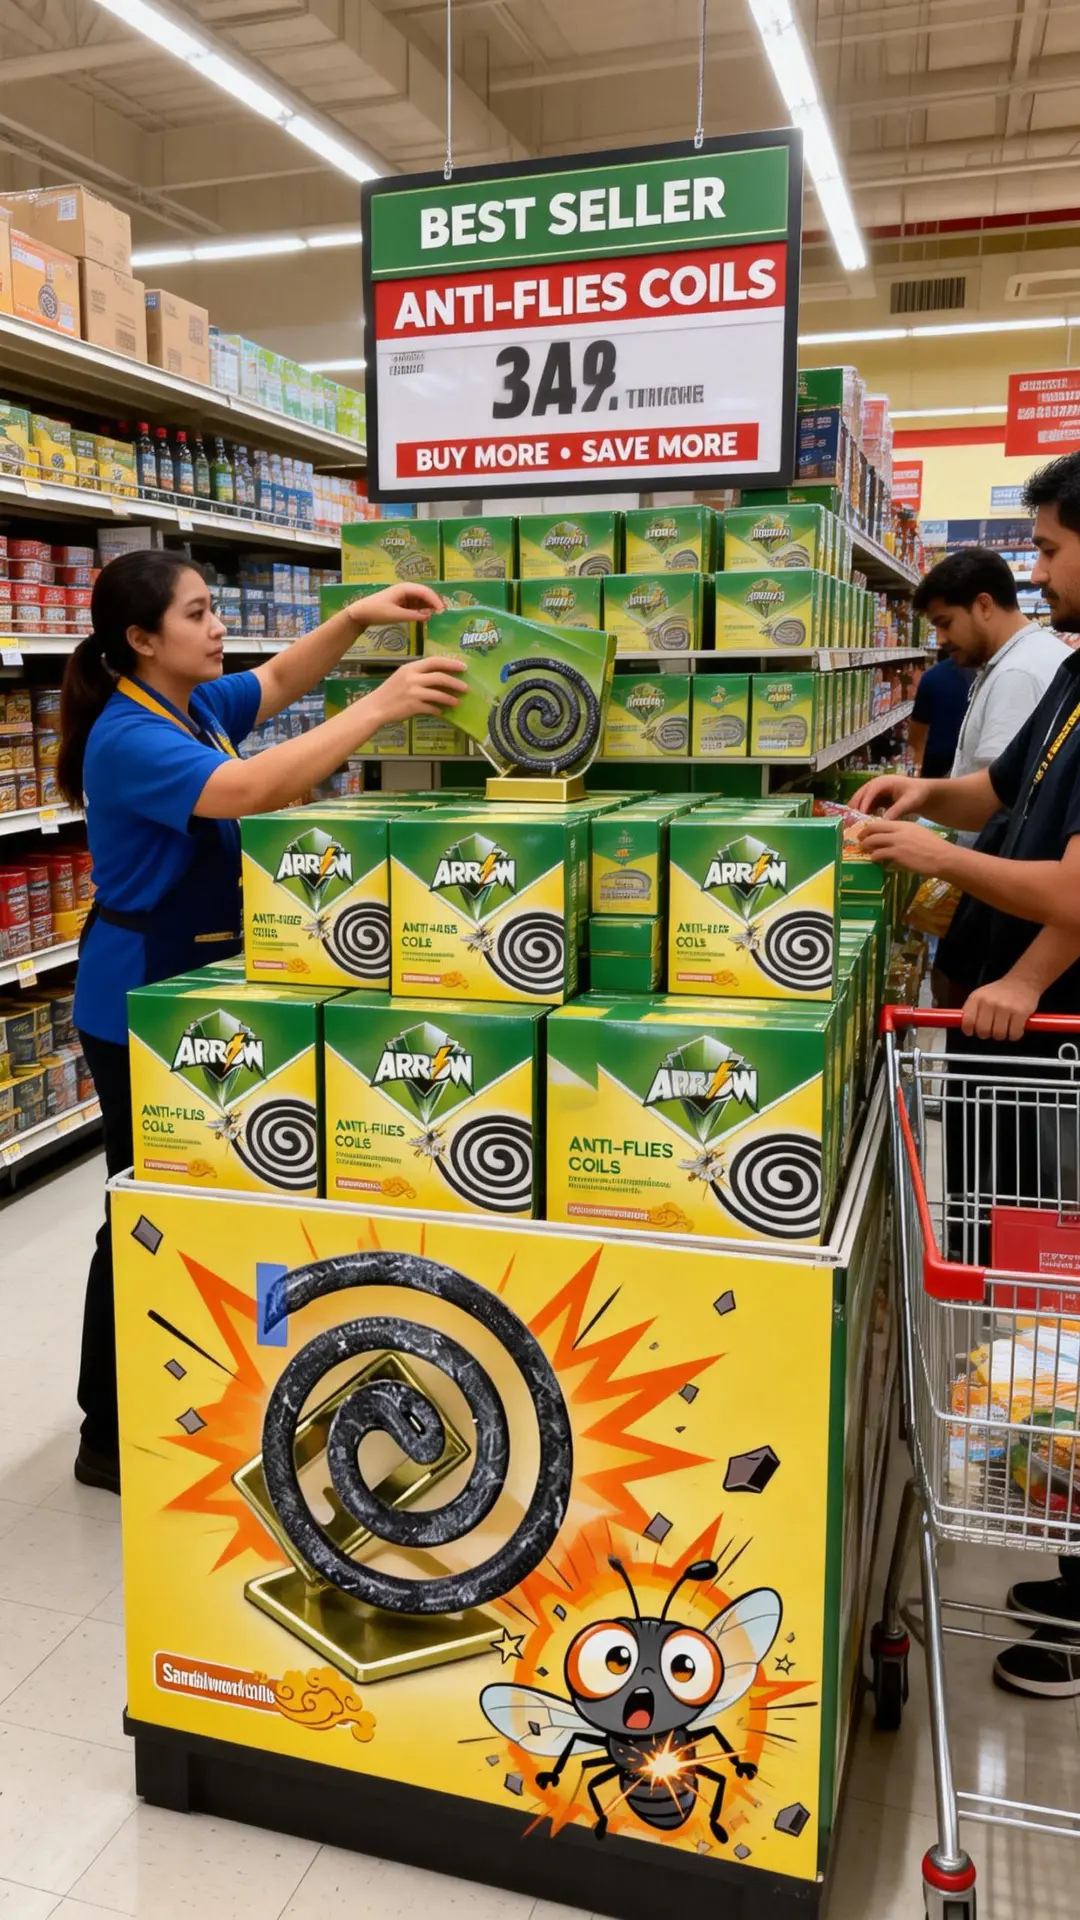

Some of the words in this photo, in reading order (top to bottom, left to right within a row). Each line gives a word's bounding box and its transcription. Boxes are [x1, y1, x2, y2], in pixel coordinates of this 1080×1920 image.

[420, 197, 536, 249] BEST
[548, 177, 726, 235] SELLER
[394, 272, 627, 329] ANTI-FLIES
[639, 259, 776, 308] COILS
[416, 447, 467, 472] BUY
[474, 441, 549, 467] MORE
[582, 436, 650, 463] SAVE
[657, 431, 738, 458] MORE
[274, 850, 353, 885] ARROW
[430, 856, 516, 893] ARROW
[701, 857, 788, 894] ARROW
[172, 1034, 266, 1078] ARROW
[371, 1048, 475, 1095] ARROW
[644, 1064, 760, 1112] ARROW
[569, 1136, 673, 1158] ANTI-FLIES
[569, 1157, 621, 1174] COILS
